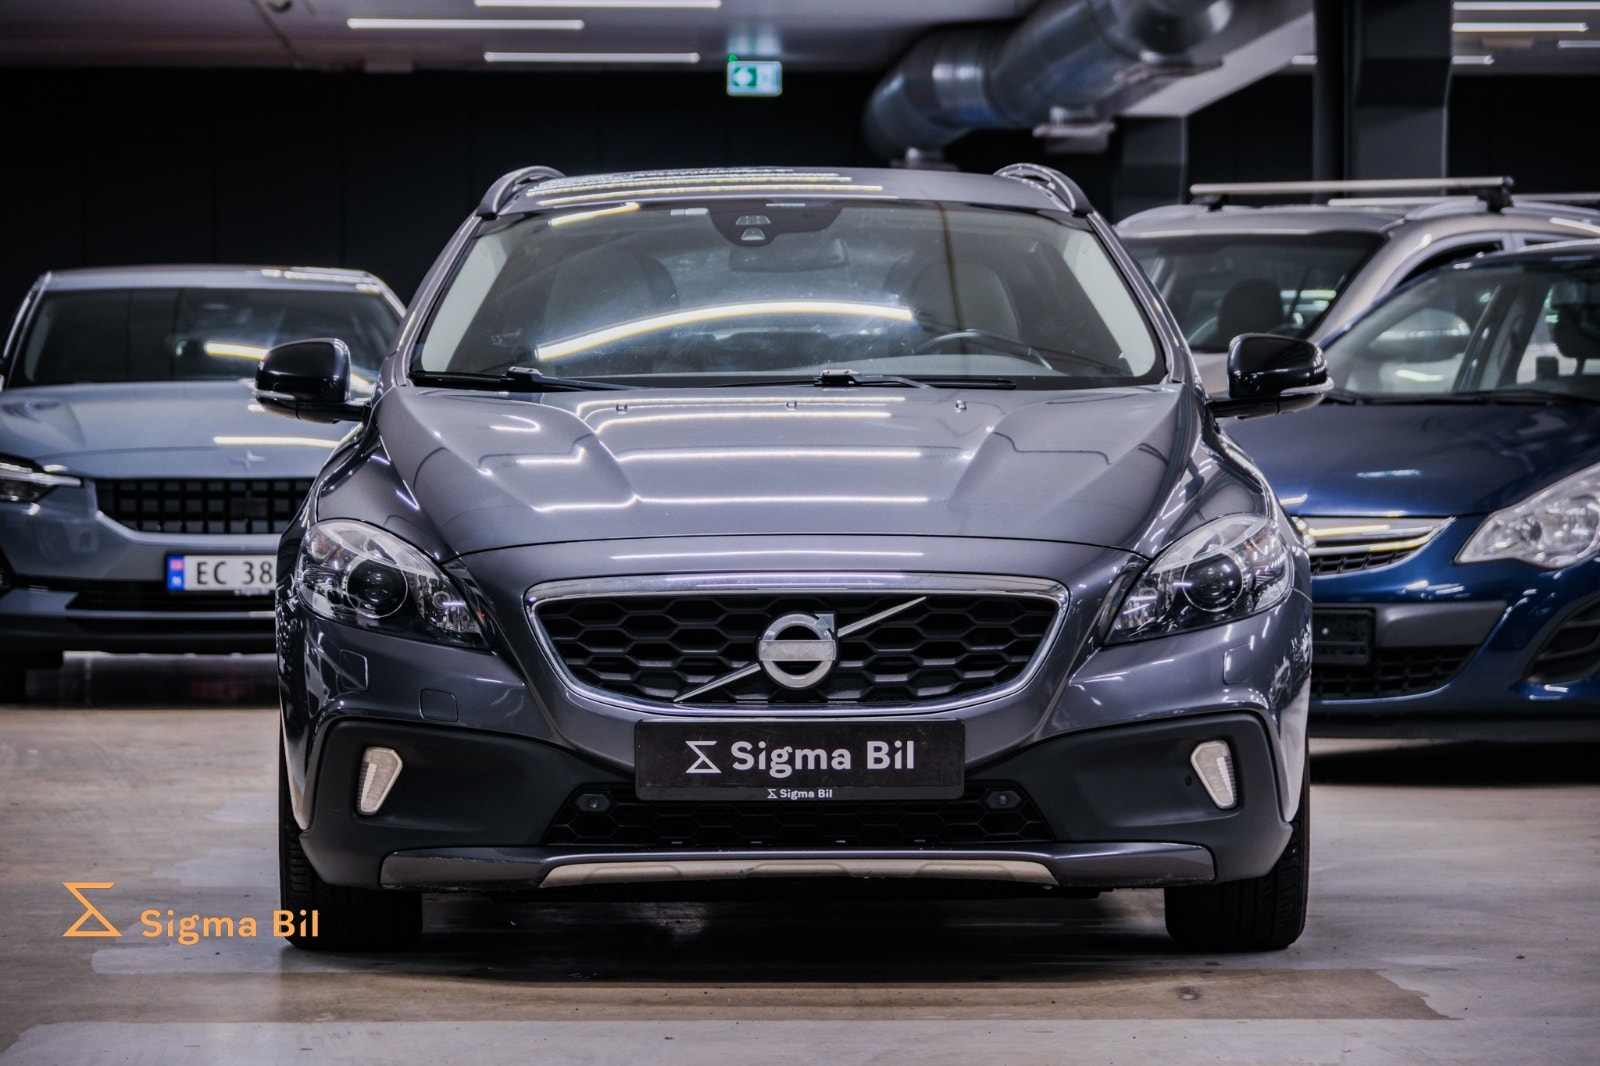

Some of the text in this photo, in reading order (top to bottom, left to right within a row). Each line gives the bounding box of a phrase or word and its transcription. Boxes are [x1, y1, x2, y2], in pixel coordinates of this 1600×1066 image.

[196, 561, 227, 585] EC
[730, 740, 914, 779] Sigma Bil
[780, 788, 833, 801] Sigma Bil
